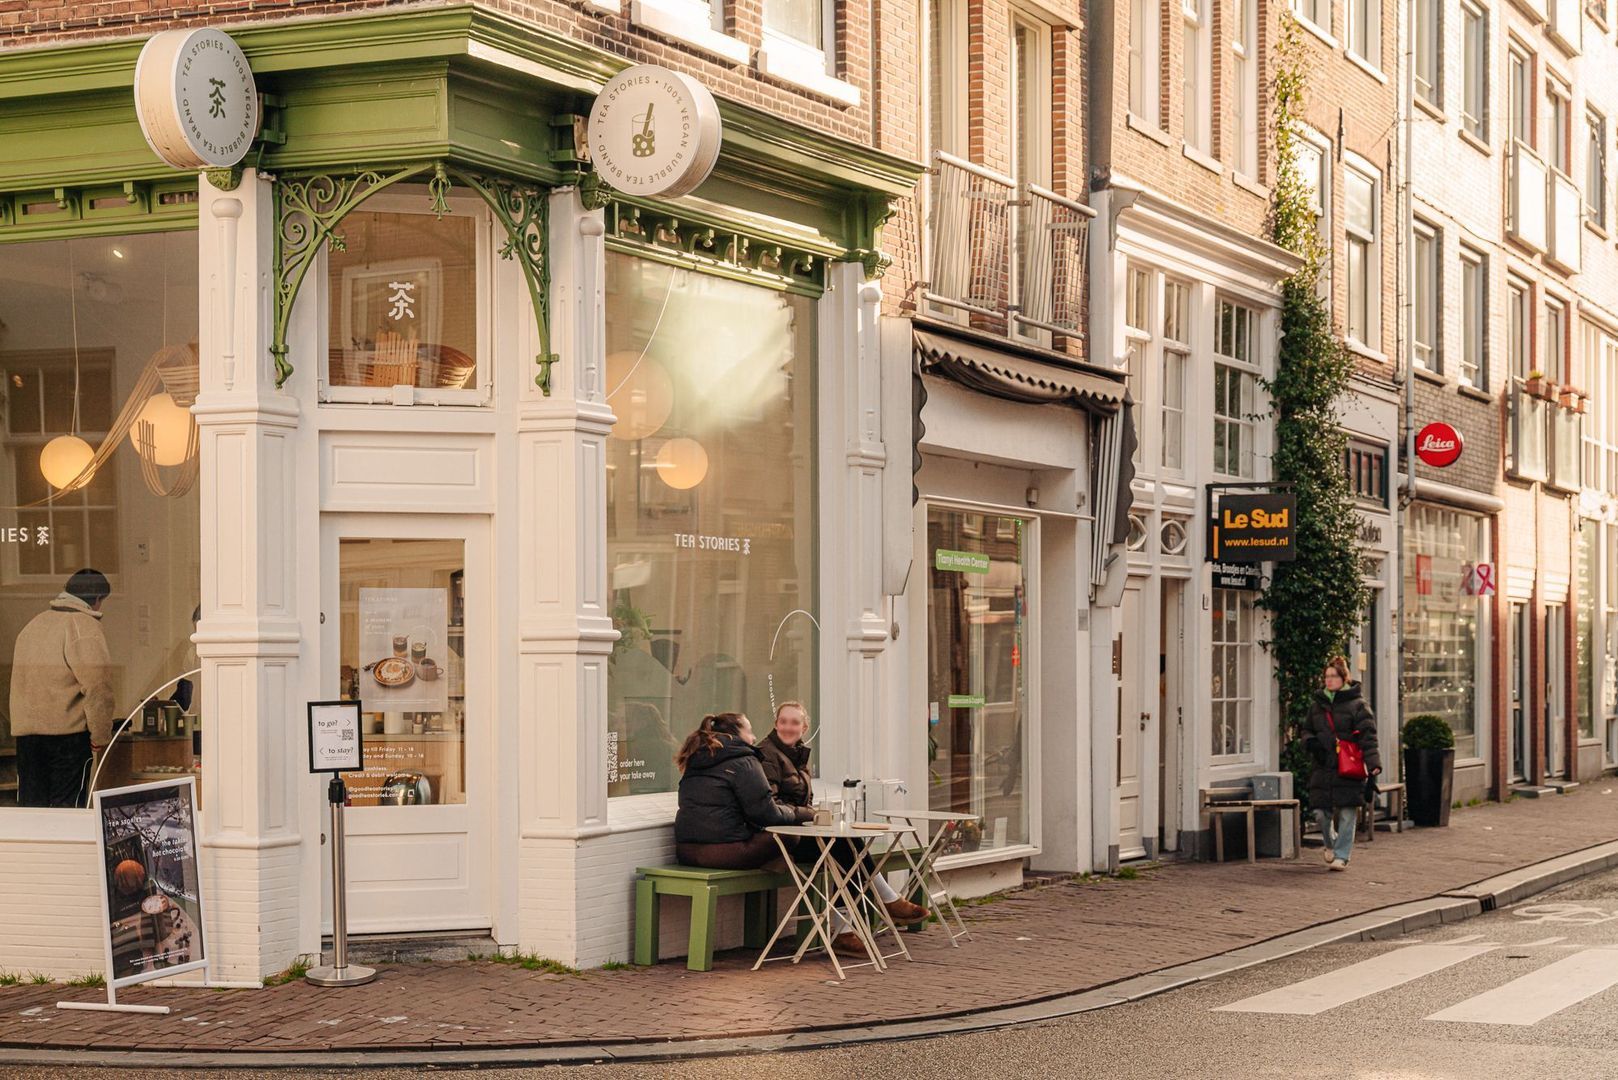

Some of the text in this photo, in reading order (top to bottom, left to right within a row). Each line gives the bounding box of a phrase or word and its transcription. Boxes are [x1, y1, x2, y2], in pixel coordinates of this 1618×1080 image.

[182, 39, 225, 77] TEA STORIES
[182, 55, 252, 155] 100% VEGAN BUBBLE TEA BRAND
[208, 77, 226, 118] 茶
[597, 76, 651, 124] TEA STORIES
[598, 82, 690, 184] 100% VEGAN BUBBLE TEA BRAND
[388, 281, 415, 320] 茶
[1418, 434, 1455, 452] Leica
[1224, 508, 1289, 529] Le Sud
[1, 527, 29, 543] IES
[698, 535, 740, 552] STORIES
[1224, 537, 1289, 547] www.lesud.nl
[337, 747, 354, 755] stay?
[619, 758, 645, 768] order here
[619, 773, 631, 782] your
[642, 771, 656, 781] away
